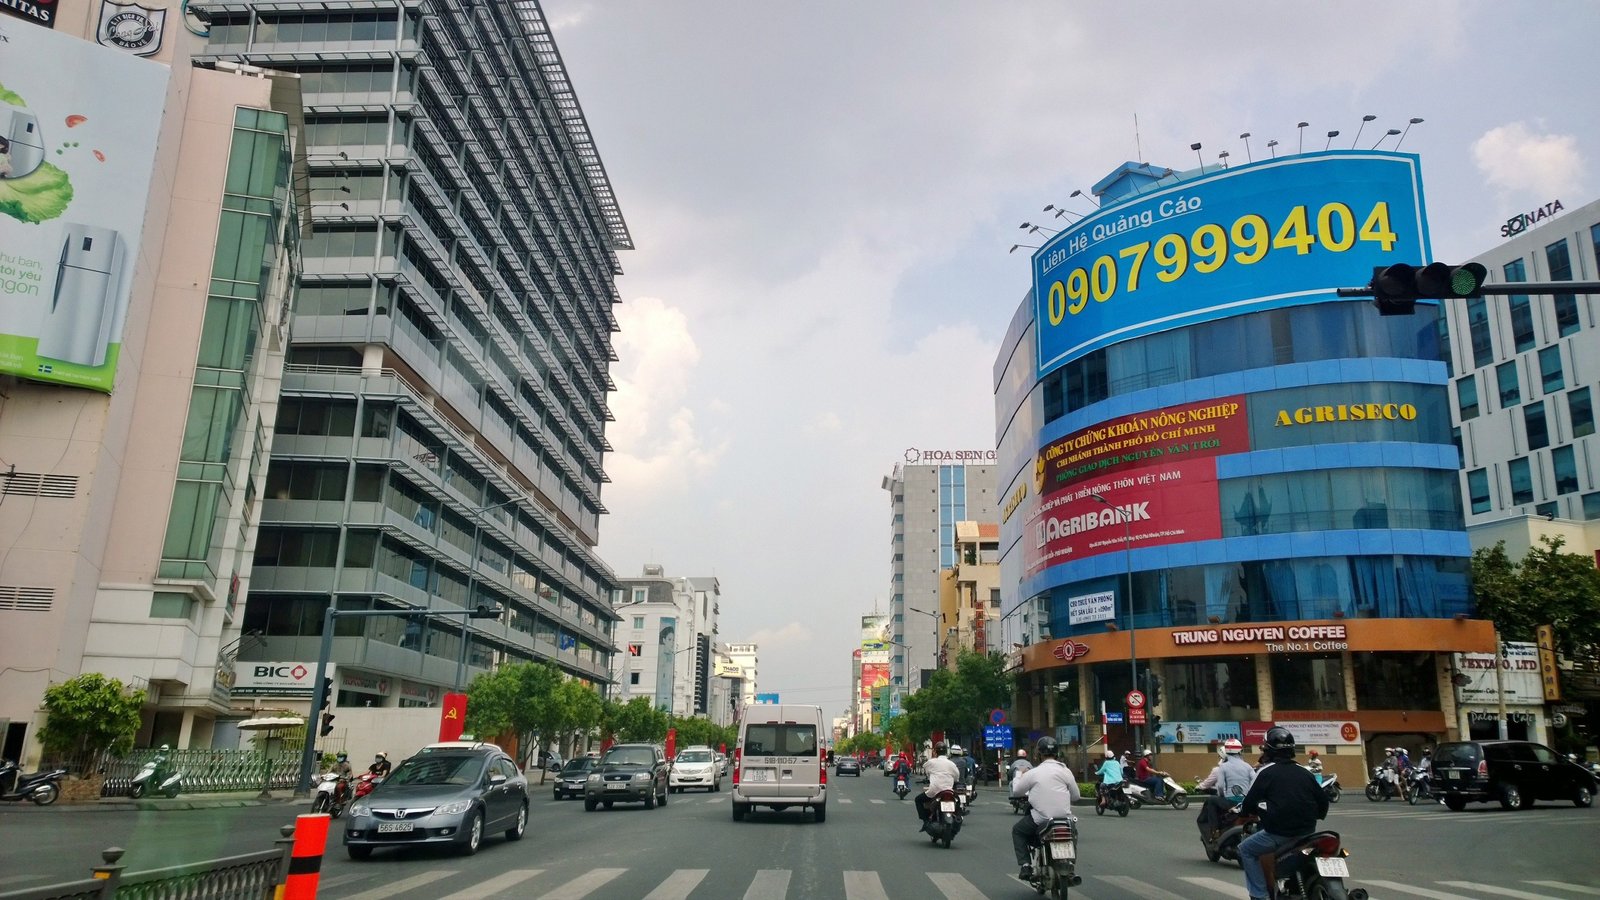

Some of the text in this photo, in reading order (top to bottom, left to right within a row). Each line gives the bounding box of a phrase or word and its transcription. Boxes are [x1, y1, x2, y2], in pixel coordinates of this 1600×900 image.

[1500, 200, 1564, 237] SONATA
[1042, 196, 1201, 273] Liên Hệ Quảng Cáo
[1048, 202, 1397, 326] 0907999404
[1274, 403, 1417, 427] AGRISECO
[1046, 402, 1238, 460] CÔNG TY CHỨNG KHOÁN NÔNG NGHIỆP
[924, 450, 997, 460] HOA SEN G
[1056, 424, 1216, 468] CHI NHÁNH THÀNH PHỐ HỒ CHÍ MINH
[1080, 462, 1097, 474] GIAO
[1099, 456, 1119, 469] DỊCH
[1092, 482, 1111, 495] NÔNG
[1113, 478, 1134, 489] THÔN
[1137, 475, 1156, 486] VIỆT
[1160, 471, 1181, 481] NAM
[1173, 626, 1346, 644] TRUNG NGUYEN COFFEE
[1265, 641, 1348, 652] The No.1 Coffee
[254, 666, 290, 678] BIC
[1461, 658, 1537, 670] TEXTAO, LTD
